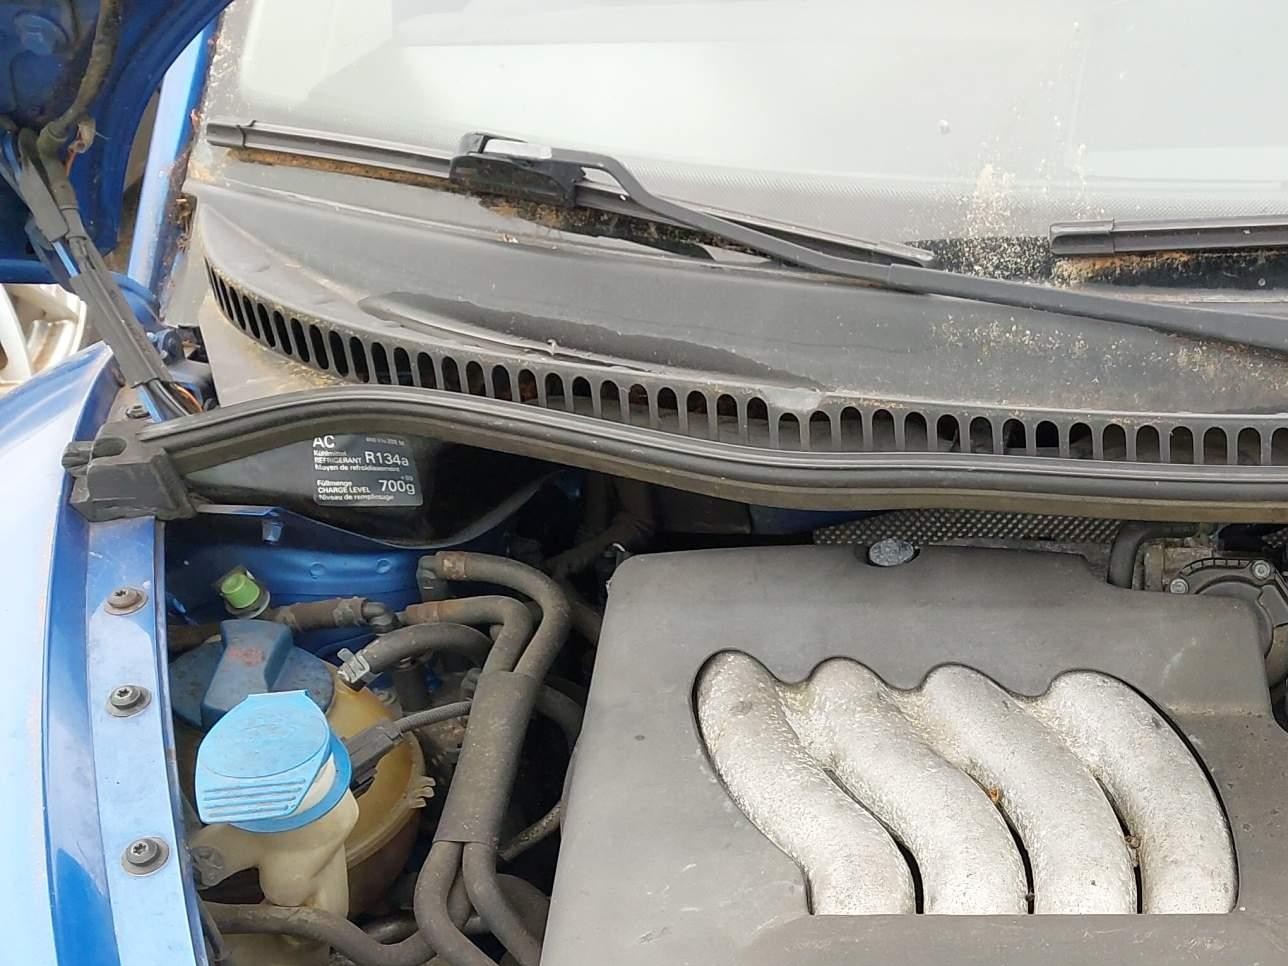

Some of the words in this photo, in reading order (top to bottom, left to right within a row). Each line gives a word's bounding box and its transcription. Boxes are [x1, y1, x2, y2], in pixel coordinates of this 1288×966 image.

[312, 435, 335, 449] AC
[364, 451, 409, 467] R134a
[379, 479, 415, 495] 700g
